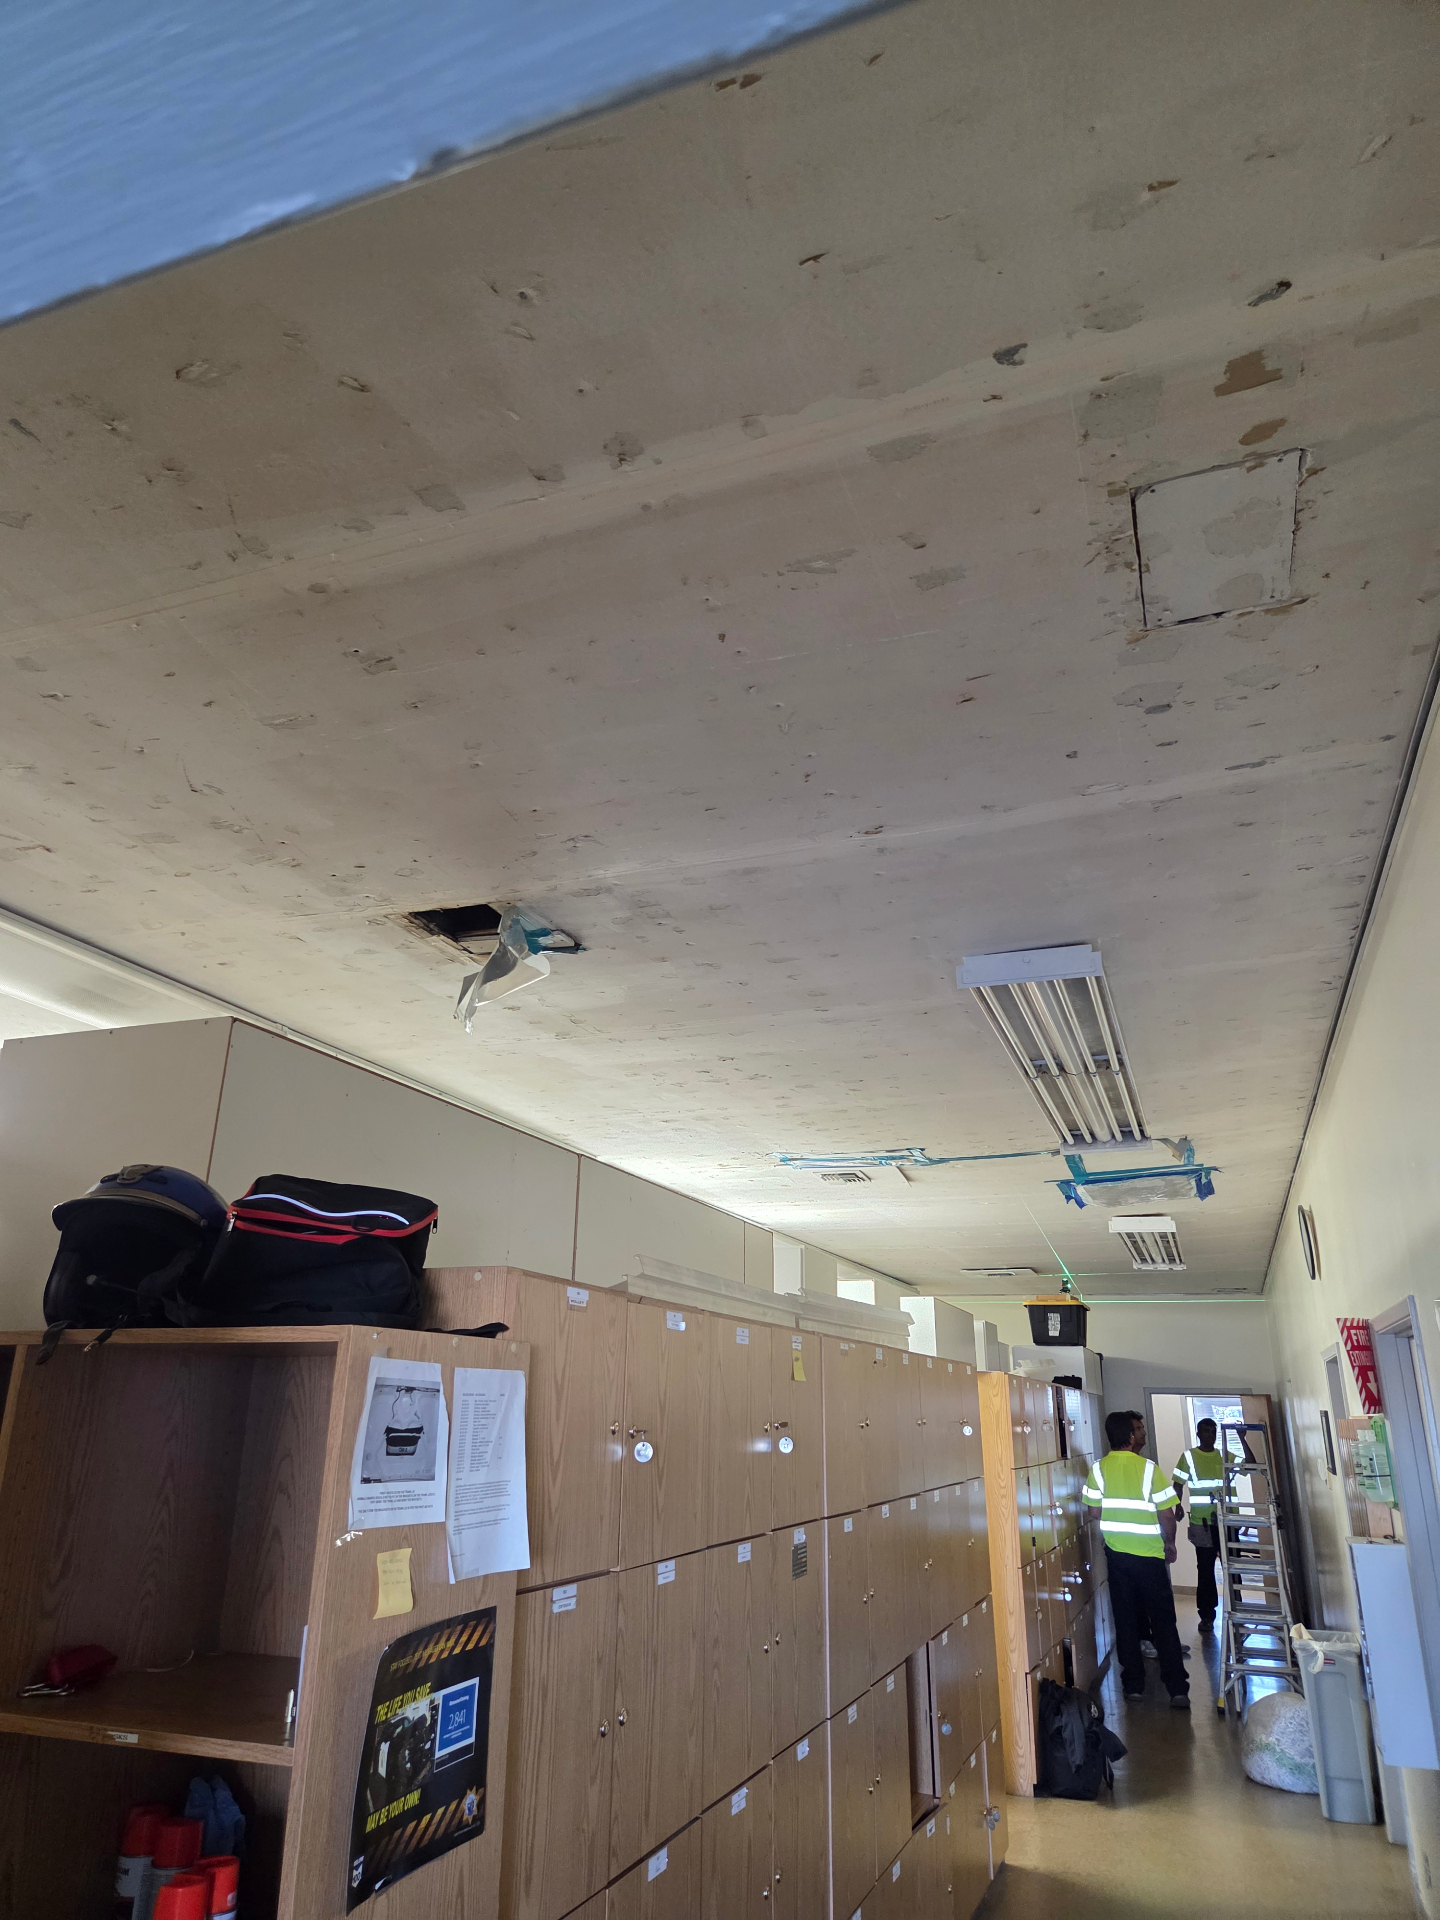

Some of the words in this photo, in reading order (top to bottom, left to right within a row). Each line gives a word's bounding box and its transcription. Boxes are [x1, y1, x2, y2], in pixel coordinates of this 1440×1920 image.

[375, 1701, 390, 1724] THE
[387, 1694, 404, 1718] LIFE
[402, 1688, 416, 1708] YOU
[448, 1709, 466, 1730] 2,841
[365, 1812, 381, 1834] MAY
[378, 1805, 391, 1826] BE
[388, 1796, 405, 1820] YOUR
[404, 1788, 422, 1811] OWN!
